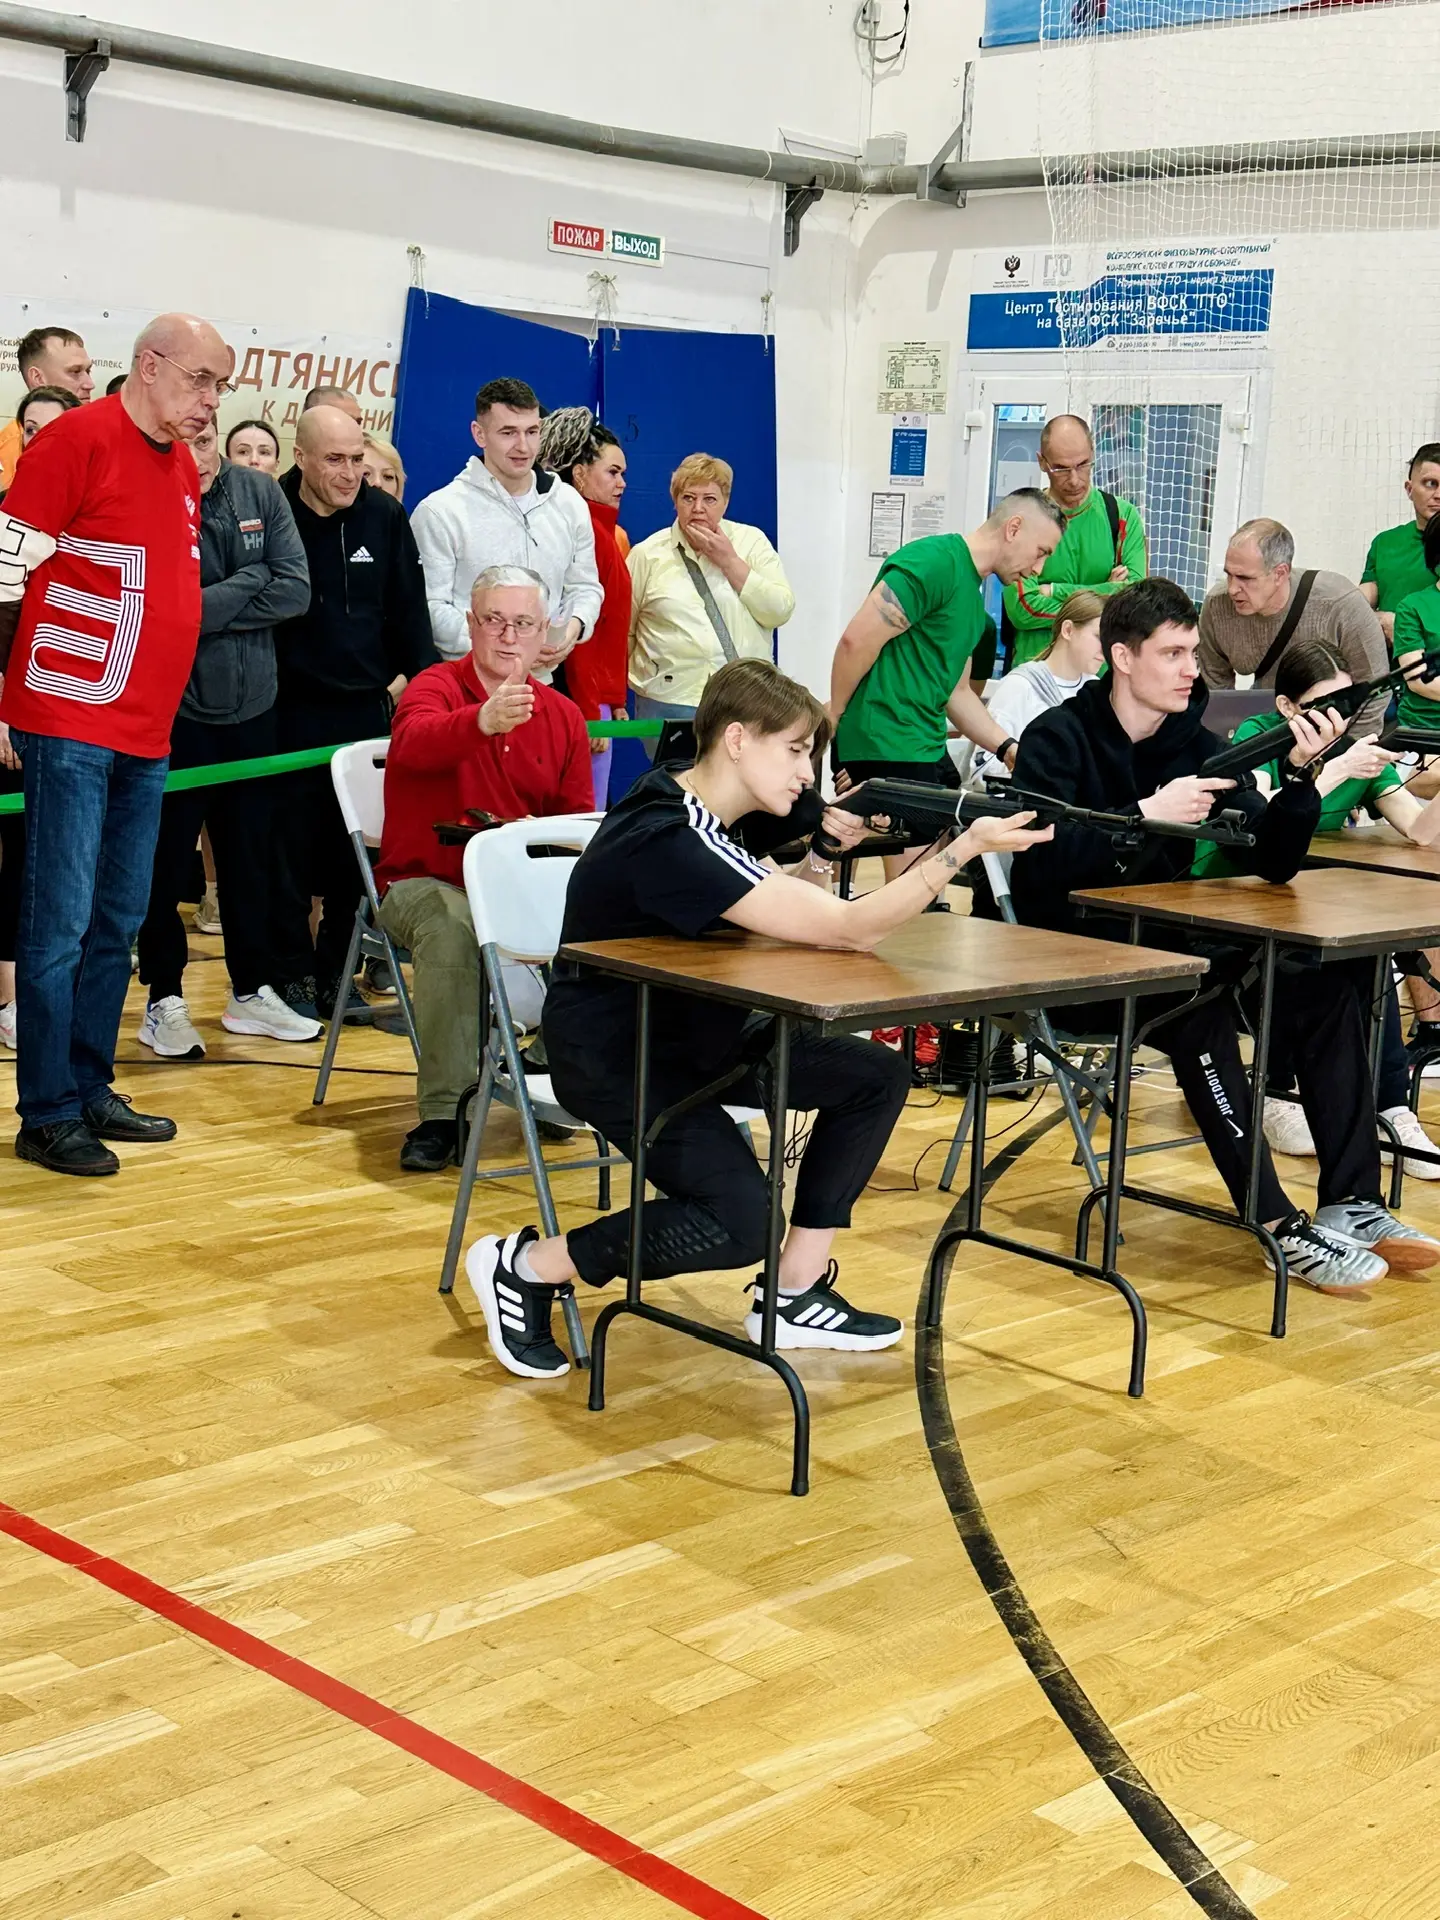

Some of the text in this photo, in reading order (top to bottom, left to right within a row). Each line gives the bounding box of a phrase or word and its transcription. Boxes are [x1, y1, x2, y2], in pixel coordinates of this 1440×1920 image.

[557, 225, 600, 248] ПОЖАР
[614, 234, 657, 258] ВЫХОД
[1005, 292, 1236, 316] Центр Тестирования ВФСК "ГТО"
[1036, 312, 1196, 329] на базе ФСК "Заречье"
[624, 413, 640, 443] 5
[242, 532, 265, 551] HH
